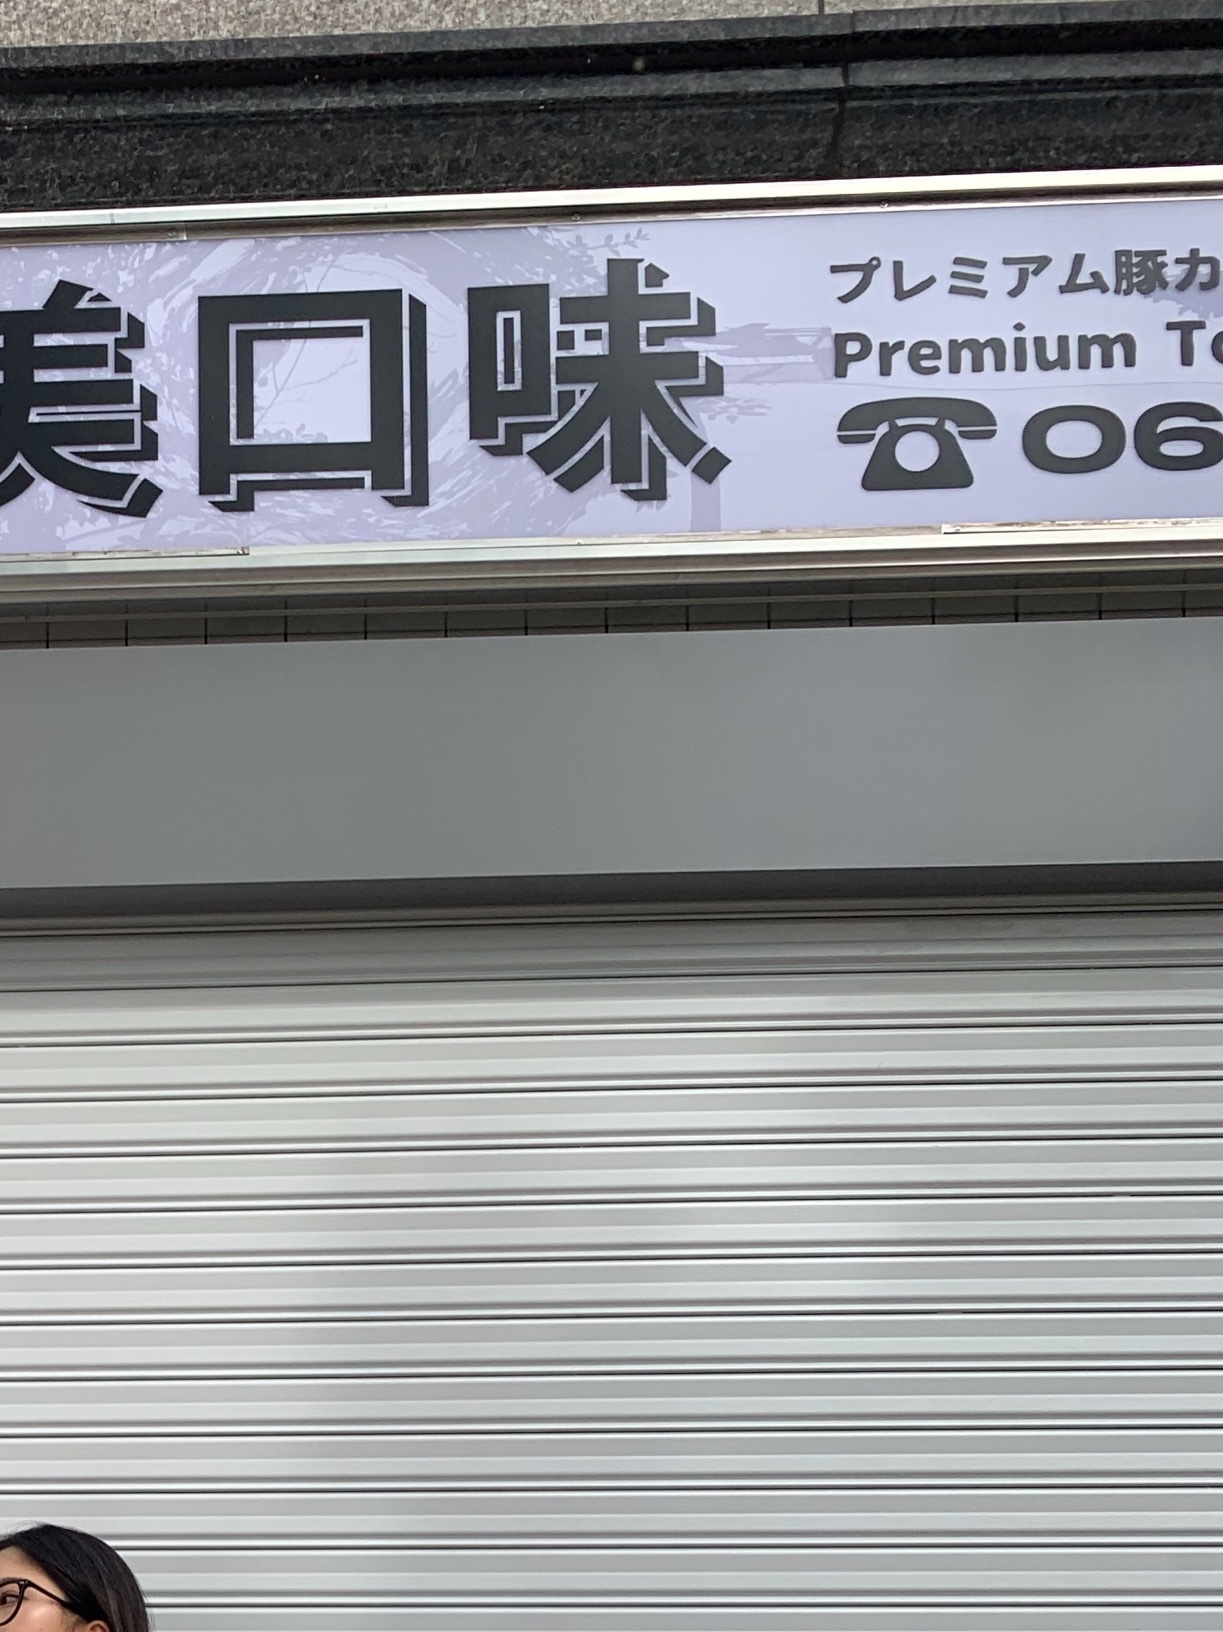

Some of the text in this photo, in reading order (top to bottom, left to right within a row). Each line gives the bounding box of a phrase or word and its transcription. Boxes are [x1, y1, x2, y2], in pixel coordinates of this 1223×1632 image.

[830, 247, 1221, 303] プレミアム豚カ
[834, 322, 1136, 378] Premium
